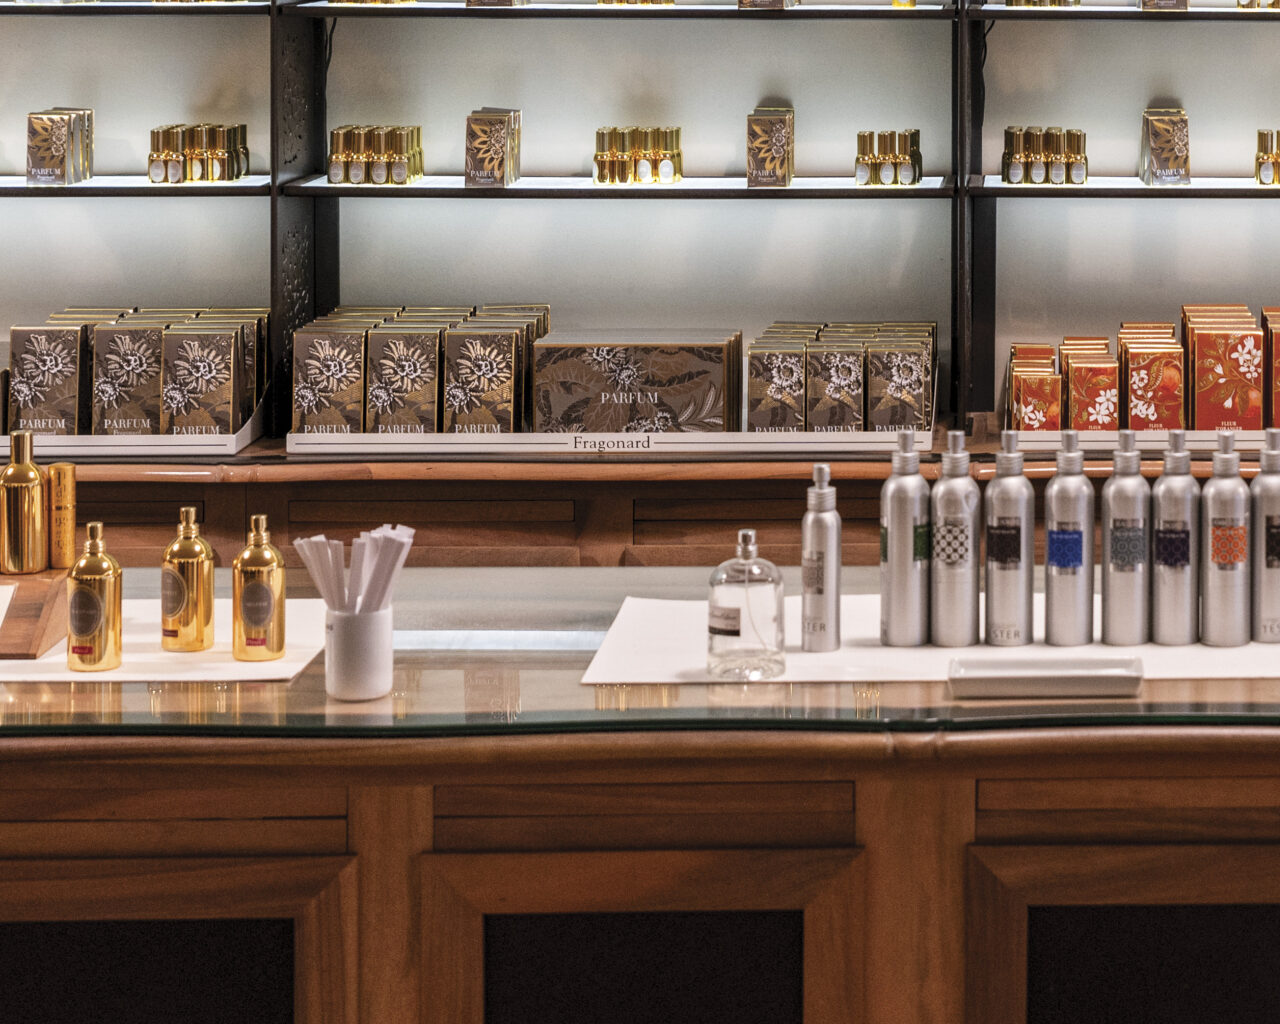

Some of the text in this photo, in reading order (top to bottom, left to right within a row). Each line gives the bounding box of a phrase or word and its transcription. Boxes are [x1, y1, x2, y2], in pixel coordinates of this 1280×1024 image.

[471, 170, 500, 178] PARFUM
[752, 169, 782, 177] PARFUM
[1157, 167, 1185, 176] PARFUM
[601, 392, 658, 404] PARFUM
[20, 419, 66, 429] PARFUM
[104, 419, 150, 429] PARFUM
[304, 424, 350, 434] PARFUM
[378, 424, 424, 434] PARFUM
[455, 424, 501, 434] PARFUM
[173, 425, 220, 435] PARFUM
[574, 436, 650, 452] Fragonard
[992, 629, 1021, 640] STER
